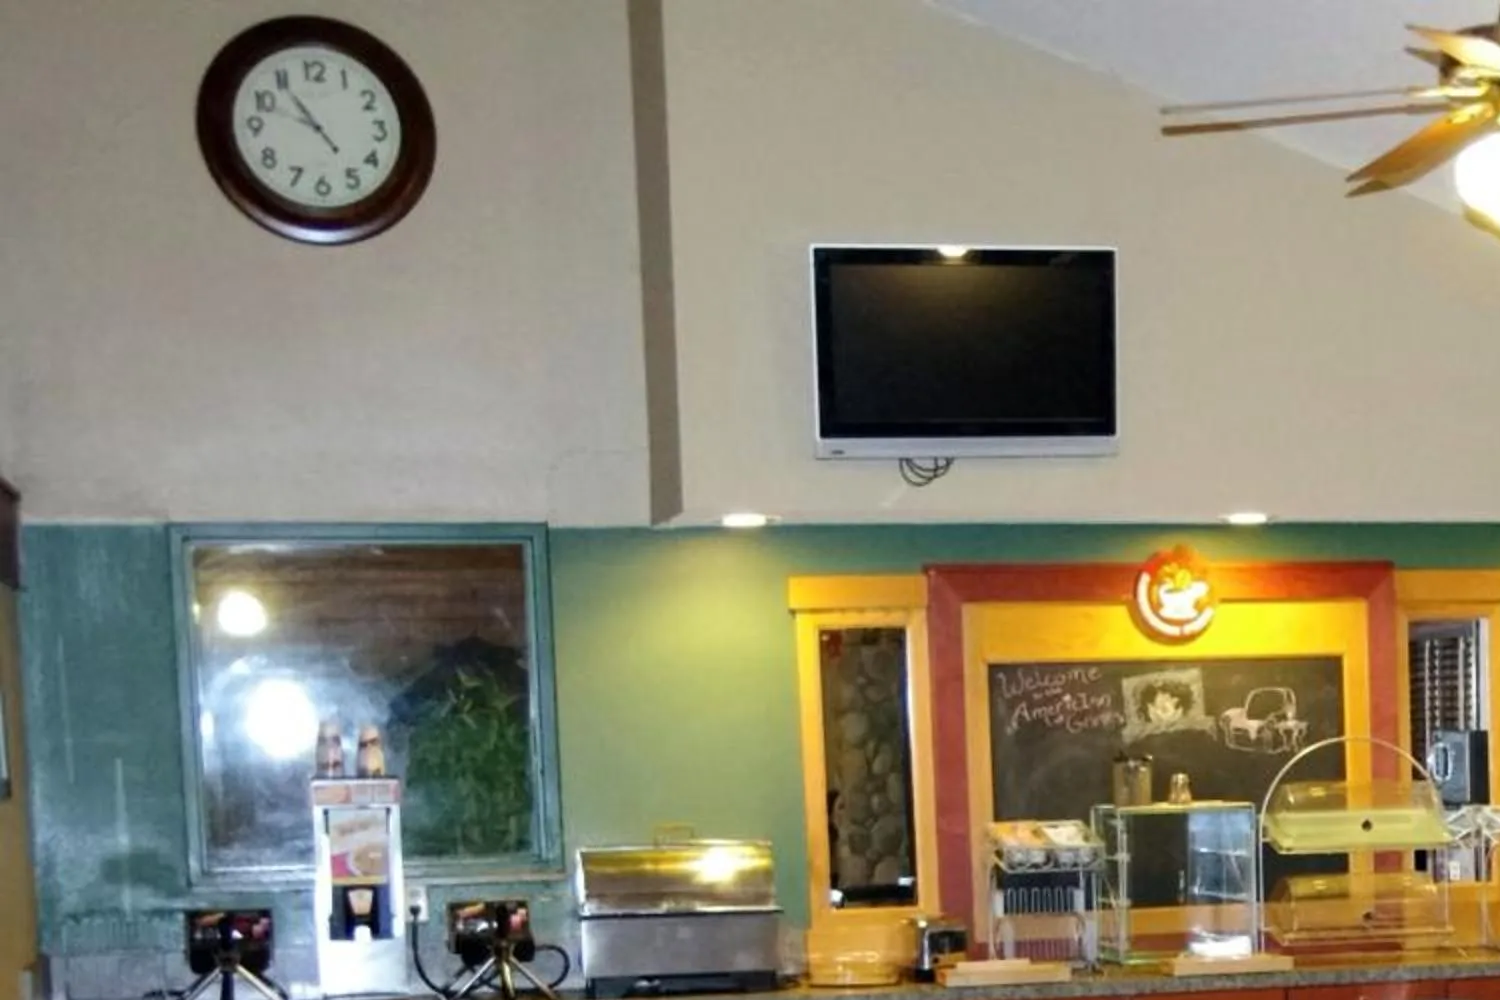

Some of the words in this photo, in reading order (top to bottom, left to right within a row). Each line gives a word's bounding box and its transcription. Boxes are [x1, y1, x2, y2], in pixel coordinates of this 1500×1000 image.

[303, 60, 326, 83] 12
[340, 68, 349, 90] 1
[255, 90, 276, 113] 10
[360, 89, 377, 111] 2
[246, 115, 264, 138] 9
[372, 119, 387, 142] 3
[261, 147, 277, 169] 8
[363, 149, 379, 168] 4
[288, 166, 303, 187] 7
[314, 176, 332, 196] 6
[345, 168, 361, 190] 5
[996, 666, 1102, 699] Welcome
